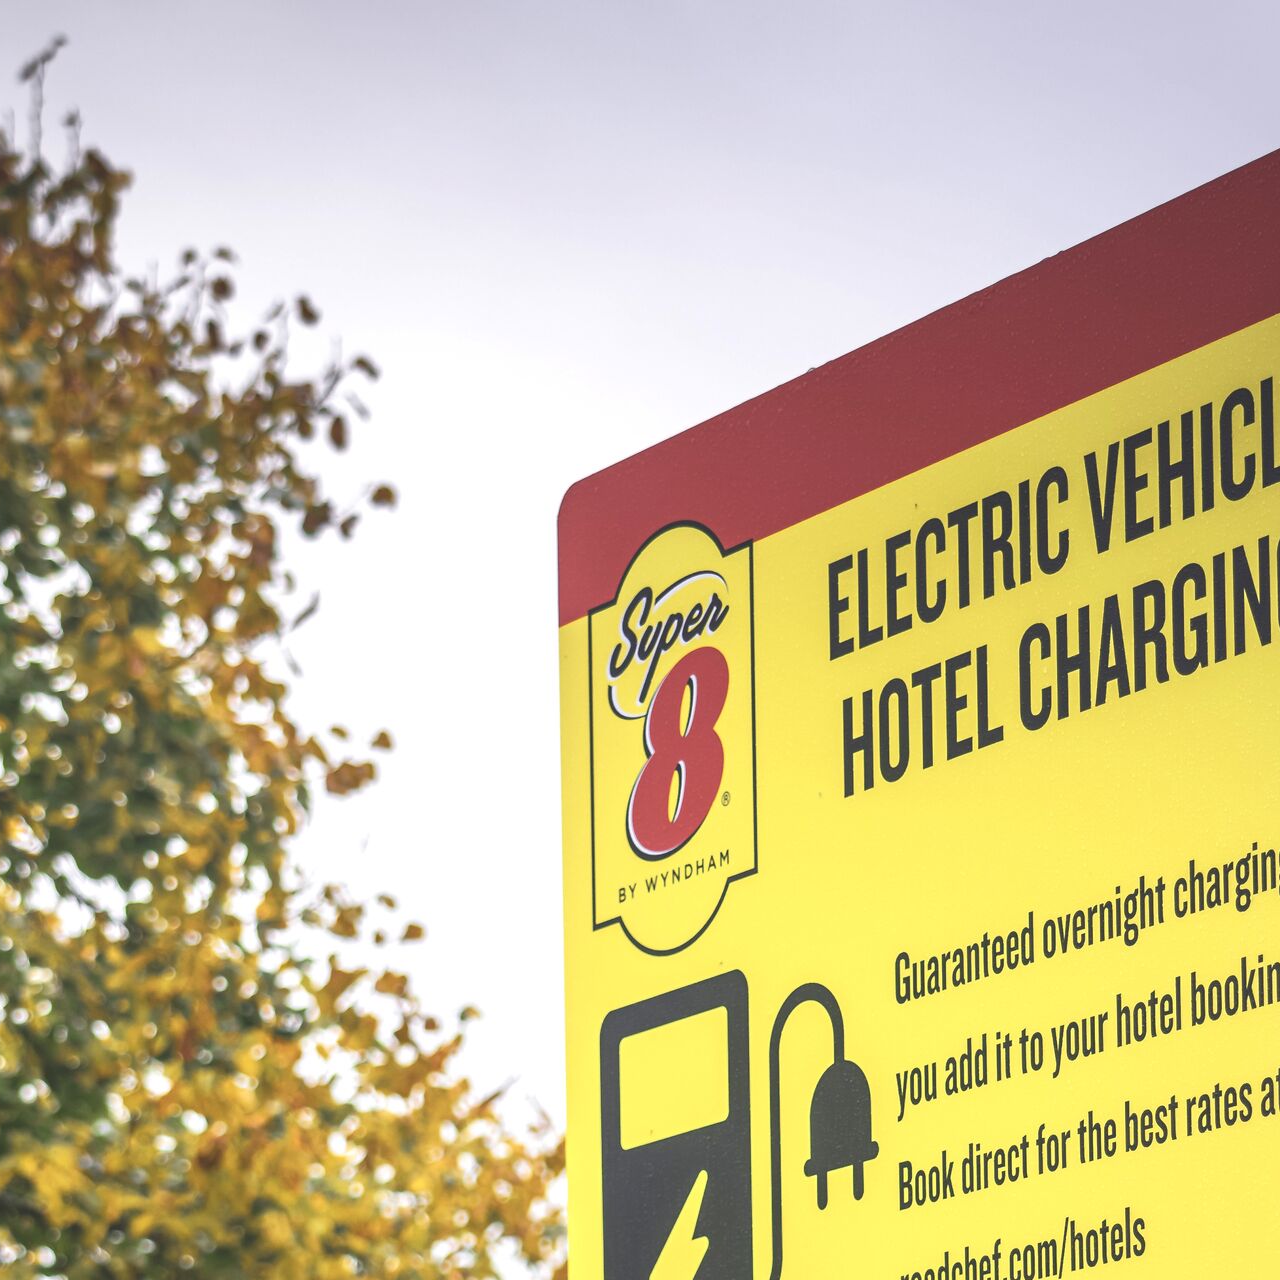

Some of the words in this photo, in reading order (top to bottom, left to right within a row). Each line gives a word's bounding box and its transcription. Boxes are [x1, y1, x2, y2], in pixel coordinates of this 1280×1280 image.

[828, 466, 1070, 660] ELECTRIC
[608, 585, 730, 704] Super
[626, 646, 730, 861] 8
[842, 644, 1004, 798] HOTEL
[618, 882, 637, 903] BY
[646, 849, 730, 892] WYNDHAM
[895, 912, 1035, 1004] Guaranteed
[1042, 875, 1165, 959] overnight
[896, 1060, 937, 1121] you
[945, 1033, 988, 1095] add
[995, 1031, 1012, 1081] it
[1019, 1027, 1044, 1075] to
[1052, 1008, 1108, 1076] your
[1116, 976, 1182, 1047] hotel
[898, 1150, 955, 1210] Book
[961, 1135, 1029, 1194] direct
[1036, 1122, 1068, 1175] for
[1077, 1111, 1116, 1163] the
[1125, 1095, 1178, 1153] best
[1186, 1081, 1253, 1136] rates
